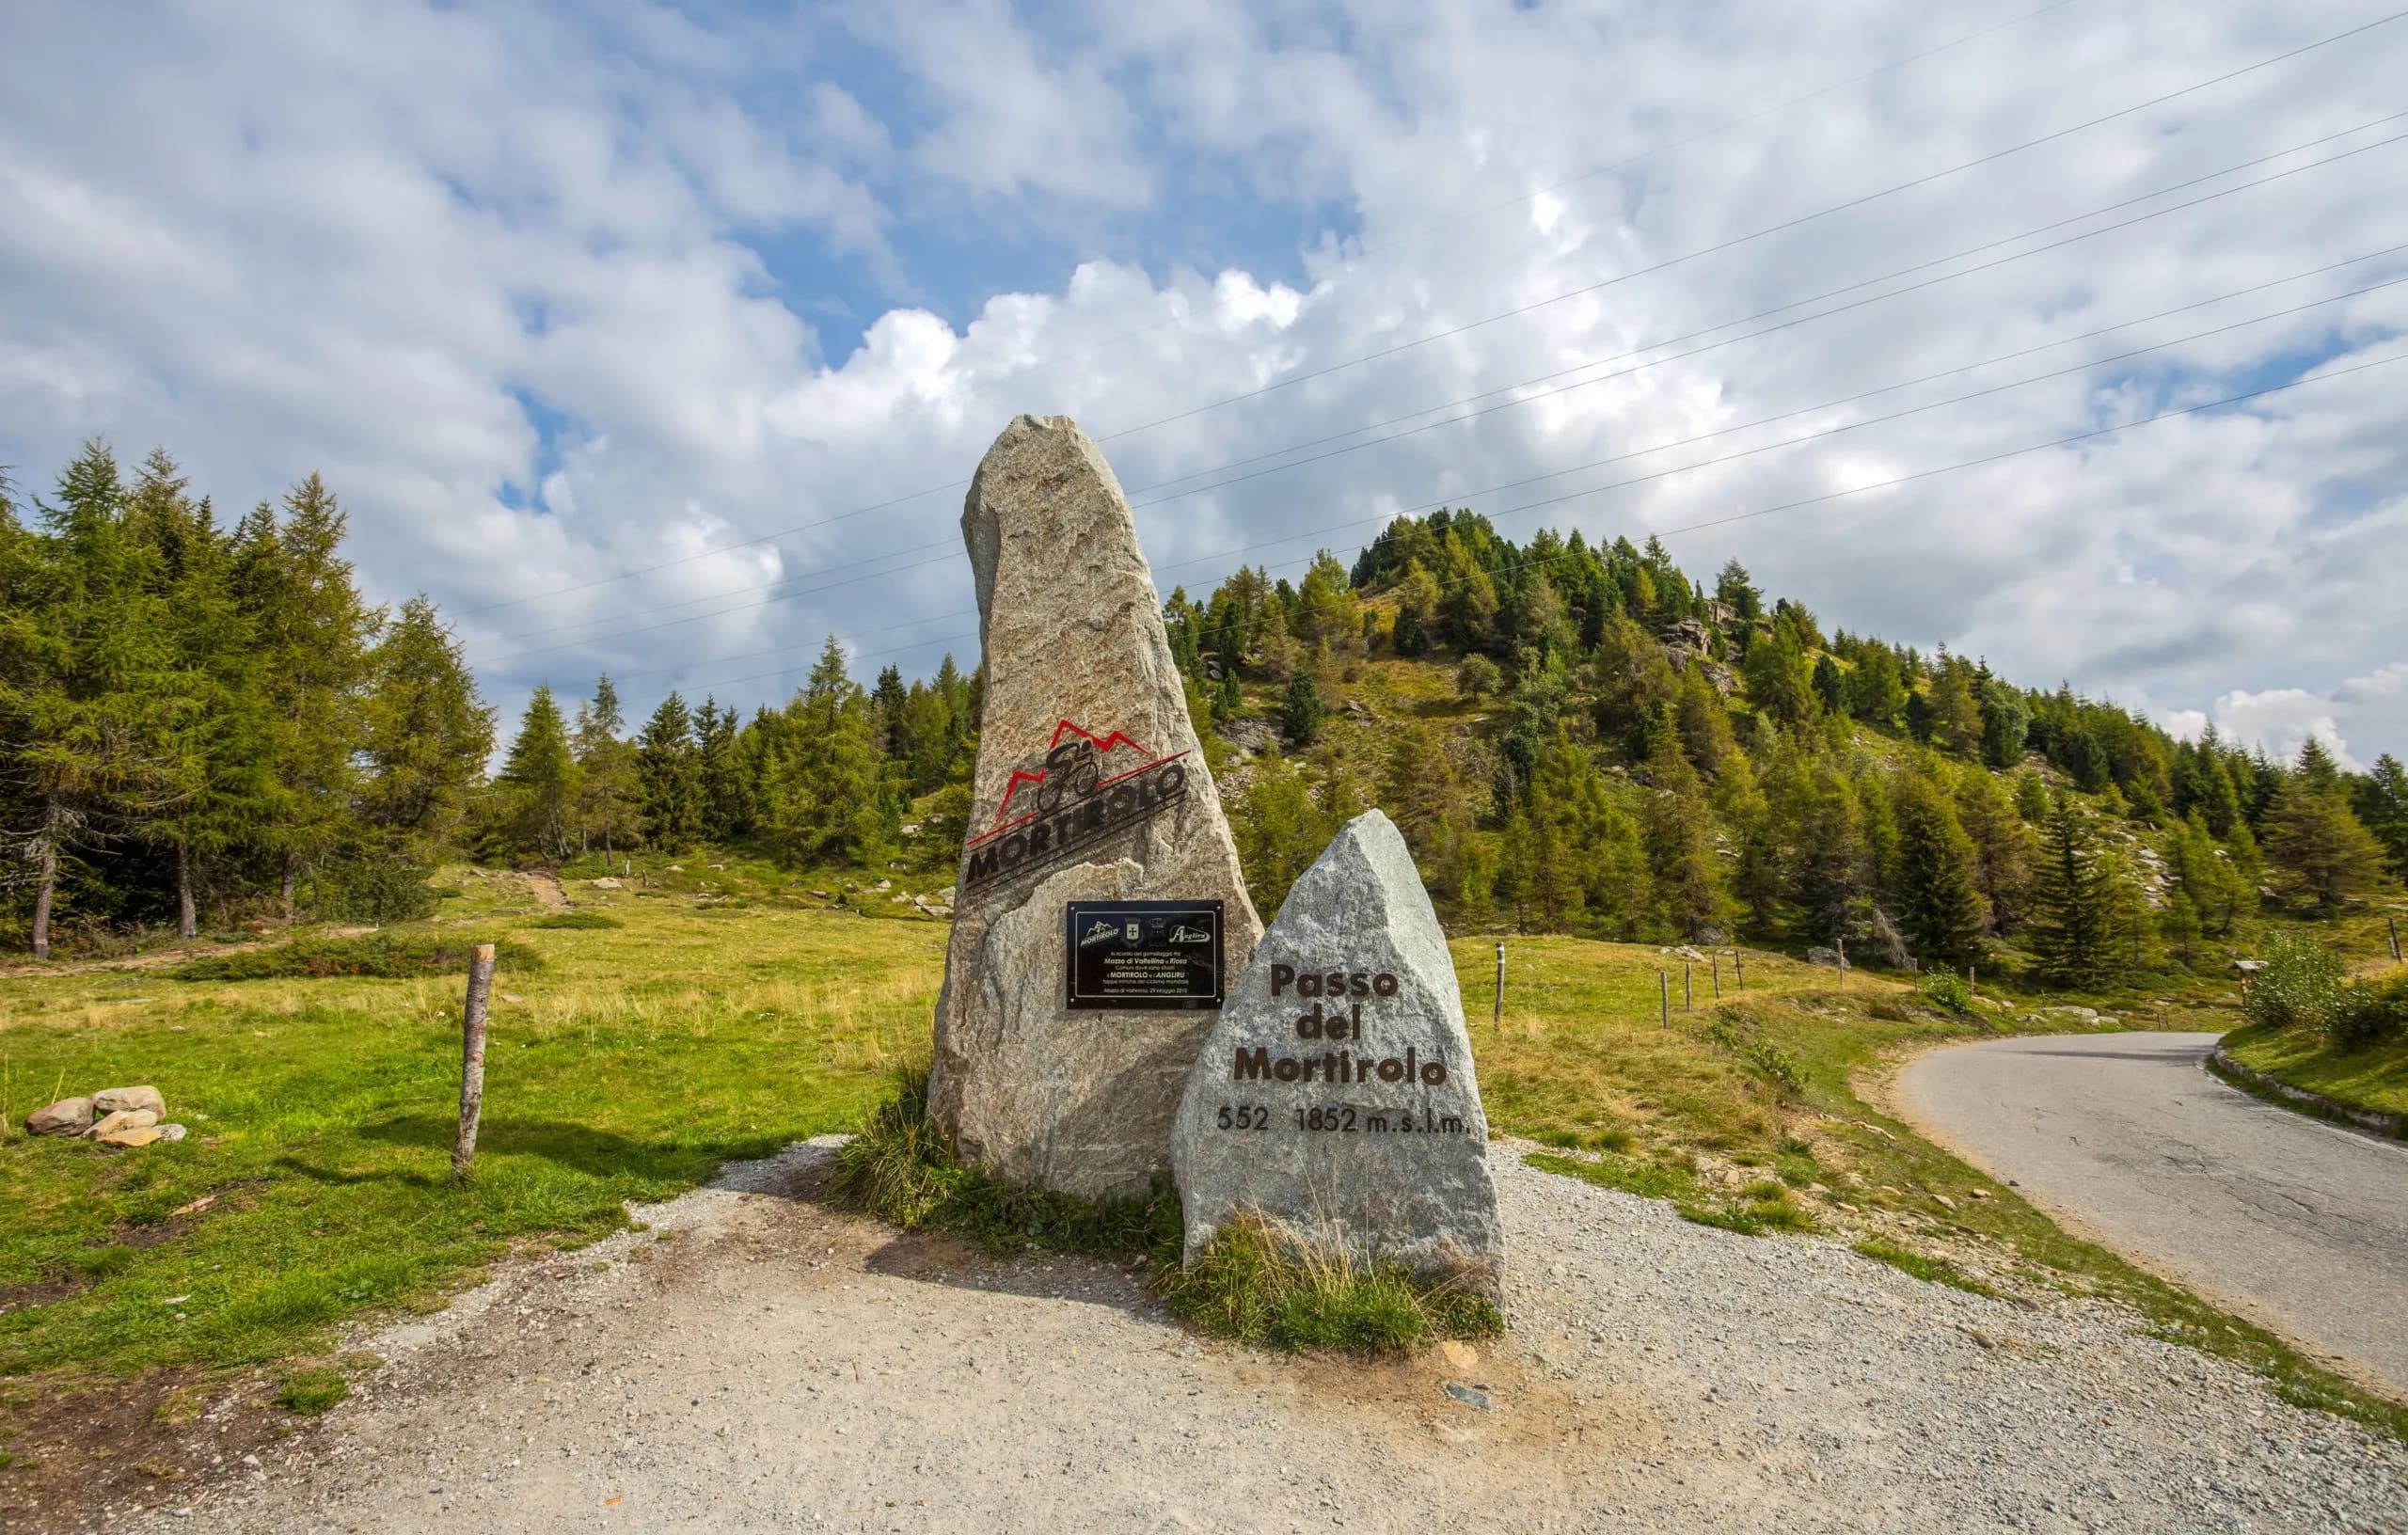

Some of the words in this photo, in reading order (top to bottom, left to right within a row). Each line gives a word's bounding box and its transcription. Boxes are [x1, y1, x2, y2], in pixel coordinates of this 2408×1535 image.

[966, 764, 1185, 882] MORTIROLO
[1081, 928, 1119, 946] MORTIROLO
[1271, 963, 1398, 997] Passo
[1296, 1004, 1360, 1040] del
[1234, 1047, 1447, 1085] Mortirolo
[1217, 1106, 1269, 1131] 552
[1295, 1108, 1356, 1131] 1852
